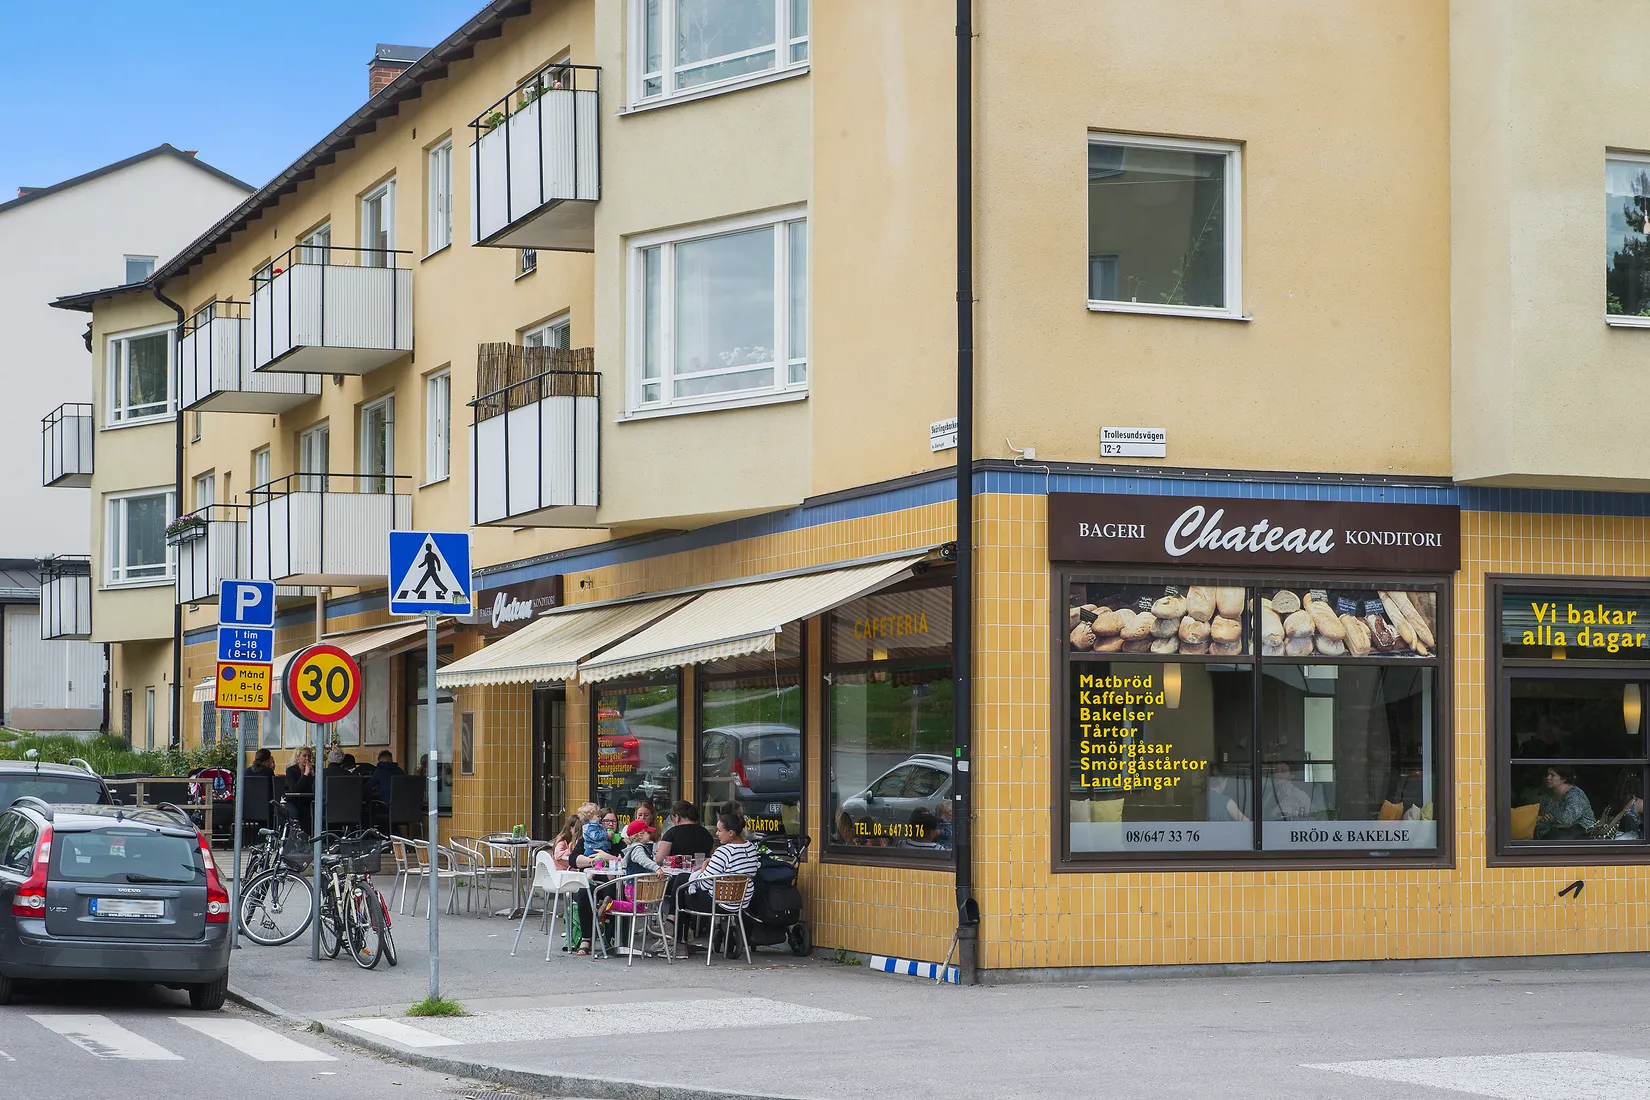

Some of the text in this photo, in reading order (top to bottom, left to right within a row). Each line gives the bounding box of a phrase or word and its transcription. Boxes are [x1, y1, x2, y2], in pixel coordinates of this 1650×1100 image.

[1103, 429, 1164, 441] Trollesundsvägen
[1103, 444, 1121, 454] 12-2
[1078, 505, 1443, 557] BAGERI Chateau KONDITORI
[235, 584, 262, 621] P
[492, 591, 533, 629] Chateau
[1531, 602, 1637, 625] Vi bakar
[853, 612, 929, 639] CAFETERIA
[243, 630, 258, 639] tim
[1522, 625, 1647, 653] alla dagar
[234, 640, 257, 649] 8-18
[239, 670, 265, 679] Månd
[1079, 674, 1152, 688] Matbröd
[240, 682, 263, 691] 8-16
[301, 664, 350, 703] 30
[221, 693, 264, 703] 1/11-15/5
[1079, 690, 1165, 705] Kaffebröd
[1080, 707, 1154, 721] Bakelser
[1080, 723, 1138, 738] Tårtor
[1080, 739, 1173, 758] Smörgåsar
[1080, 756, 1208, 775] Smörgåstårtor
[1080, 772, 1181, 791] Landgångar
[855, 822, 871, 835] TEL.
[873, 822, 882, 836] 08
[889, 823, 902, 837] 647
[904, 824, 913, 837] 33
[915, 824, 924, 838] 76
[1125, 830, 1200, 843] 08/647 33 76
[1290, 828, 1410, 843] BRÖD & BAKELSE
